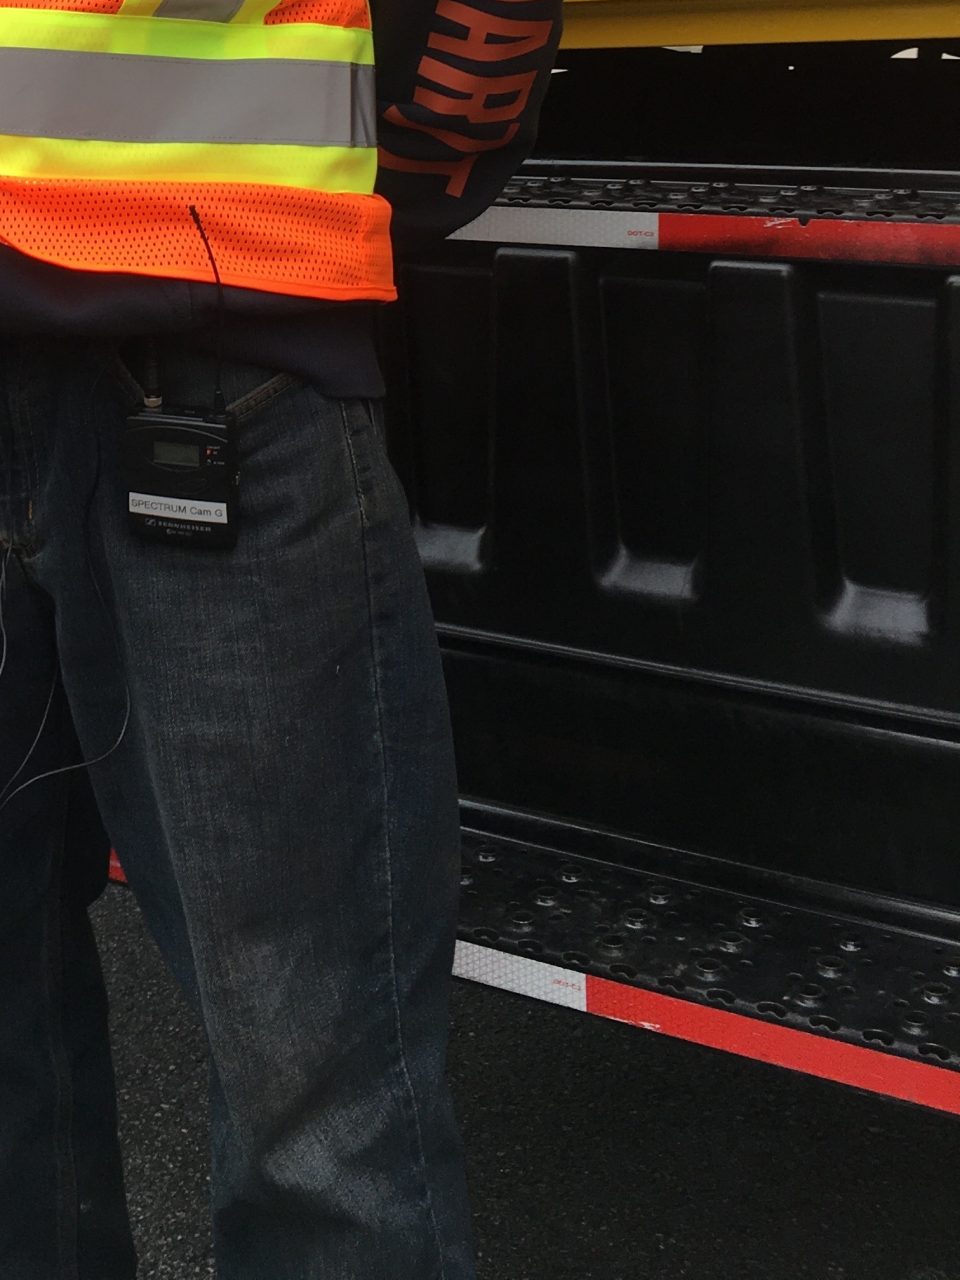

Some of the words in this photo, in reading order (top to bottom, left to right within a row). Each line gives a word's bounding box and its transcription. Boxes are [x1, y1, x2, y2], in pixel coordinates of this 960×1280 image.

[131, 498, 187, 515] SPECTRUM
[190, 507, 212, 517] Cam
[214, 508, 223, 518] G
